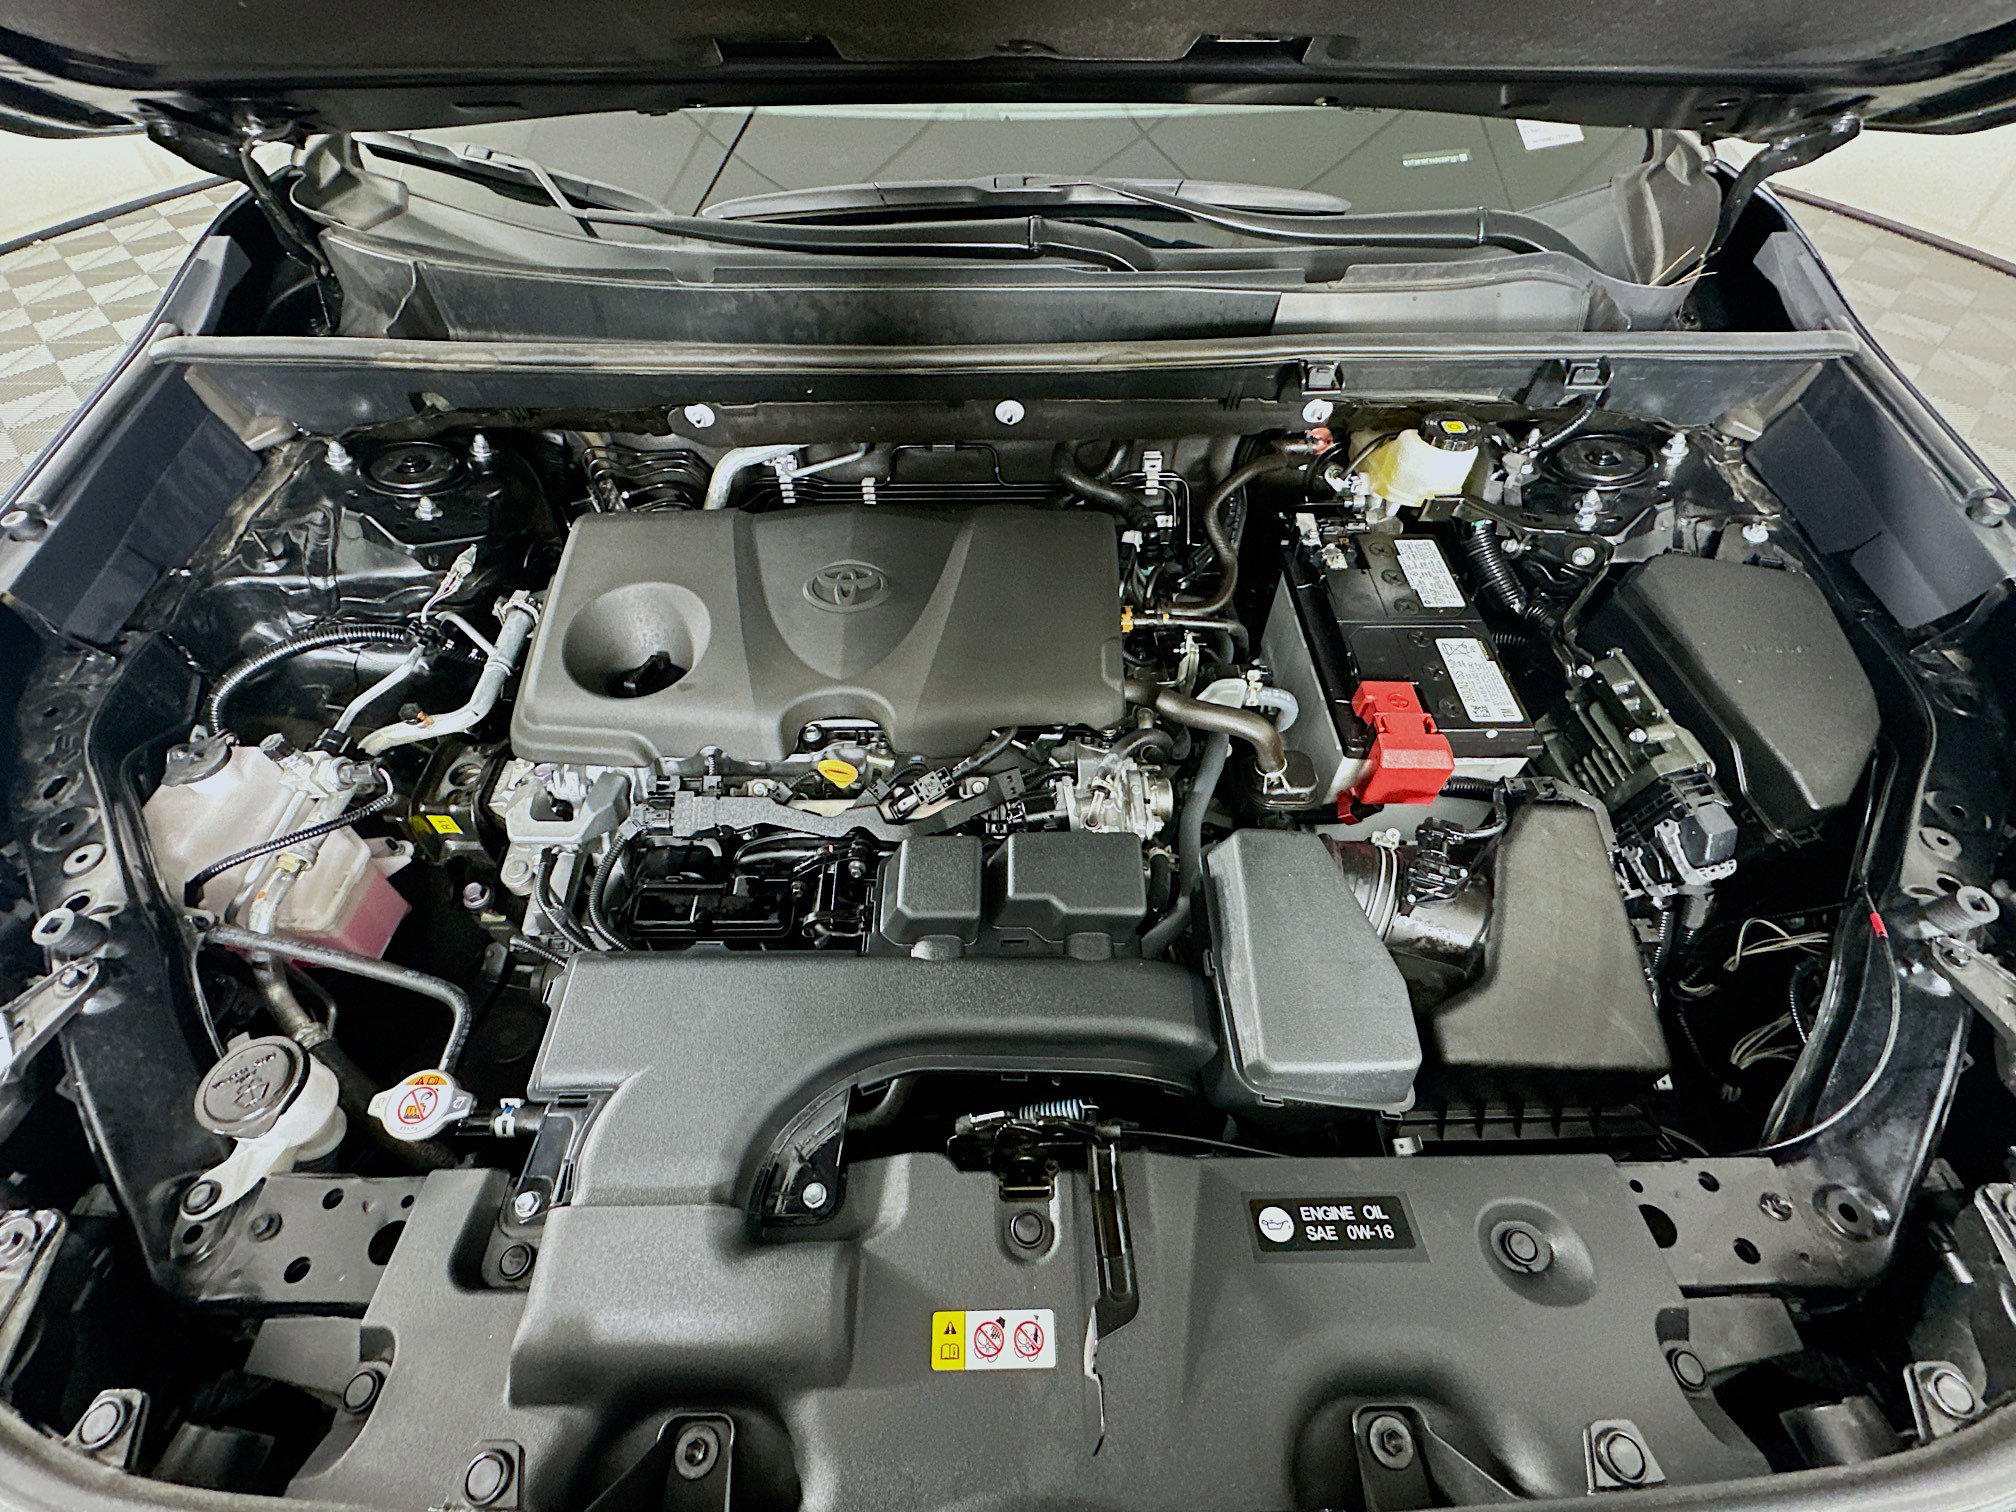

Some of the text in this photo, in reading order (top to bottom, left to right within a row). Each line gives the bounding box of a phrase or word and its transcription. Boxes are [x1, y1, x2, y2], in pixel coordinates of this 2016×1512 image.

[1300, 1205, 1389, 1221] ENGINE OIL
[1306, 1224, 1395, 1241] SAE 0W-16
